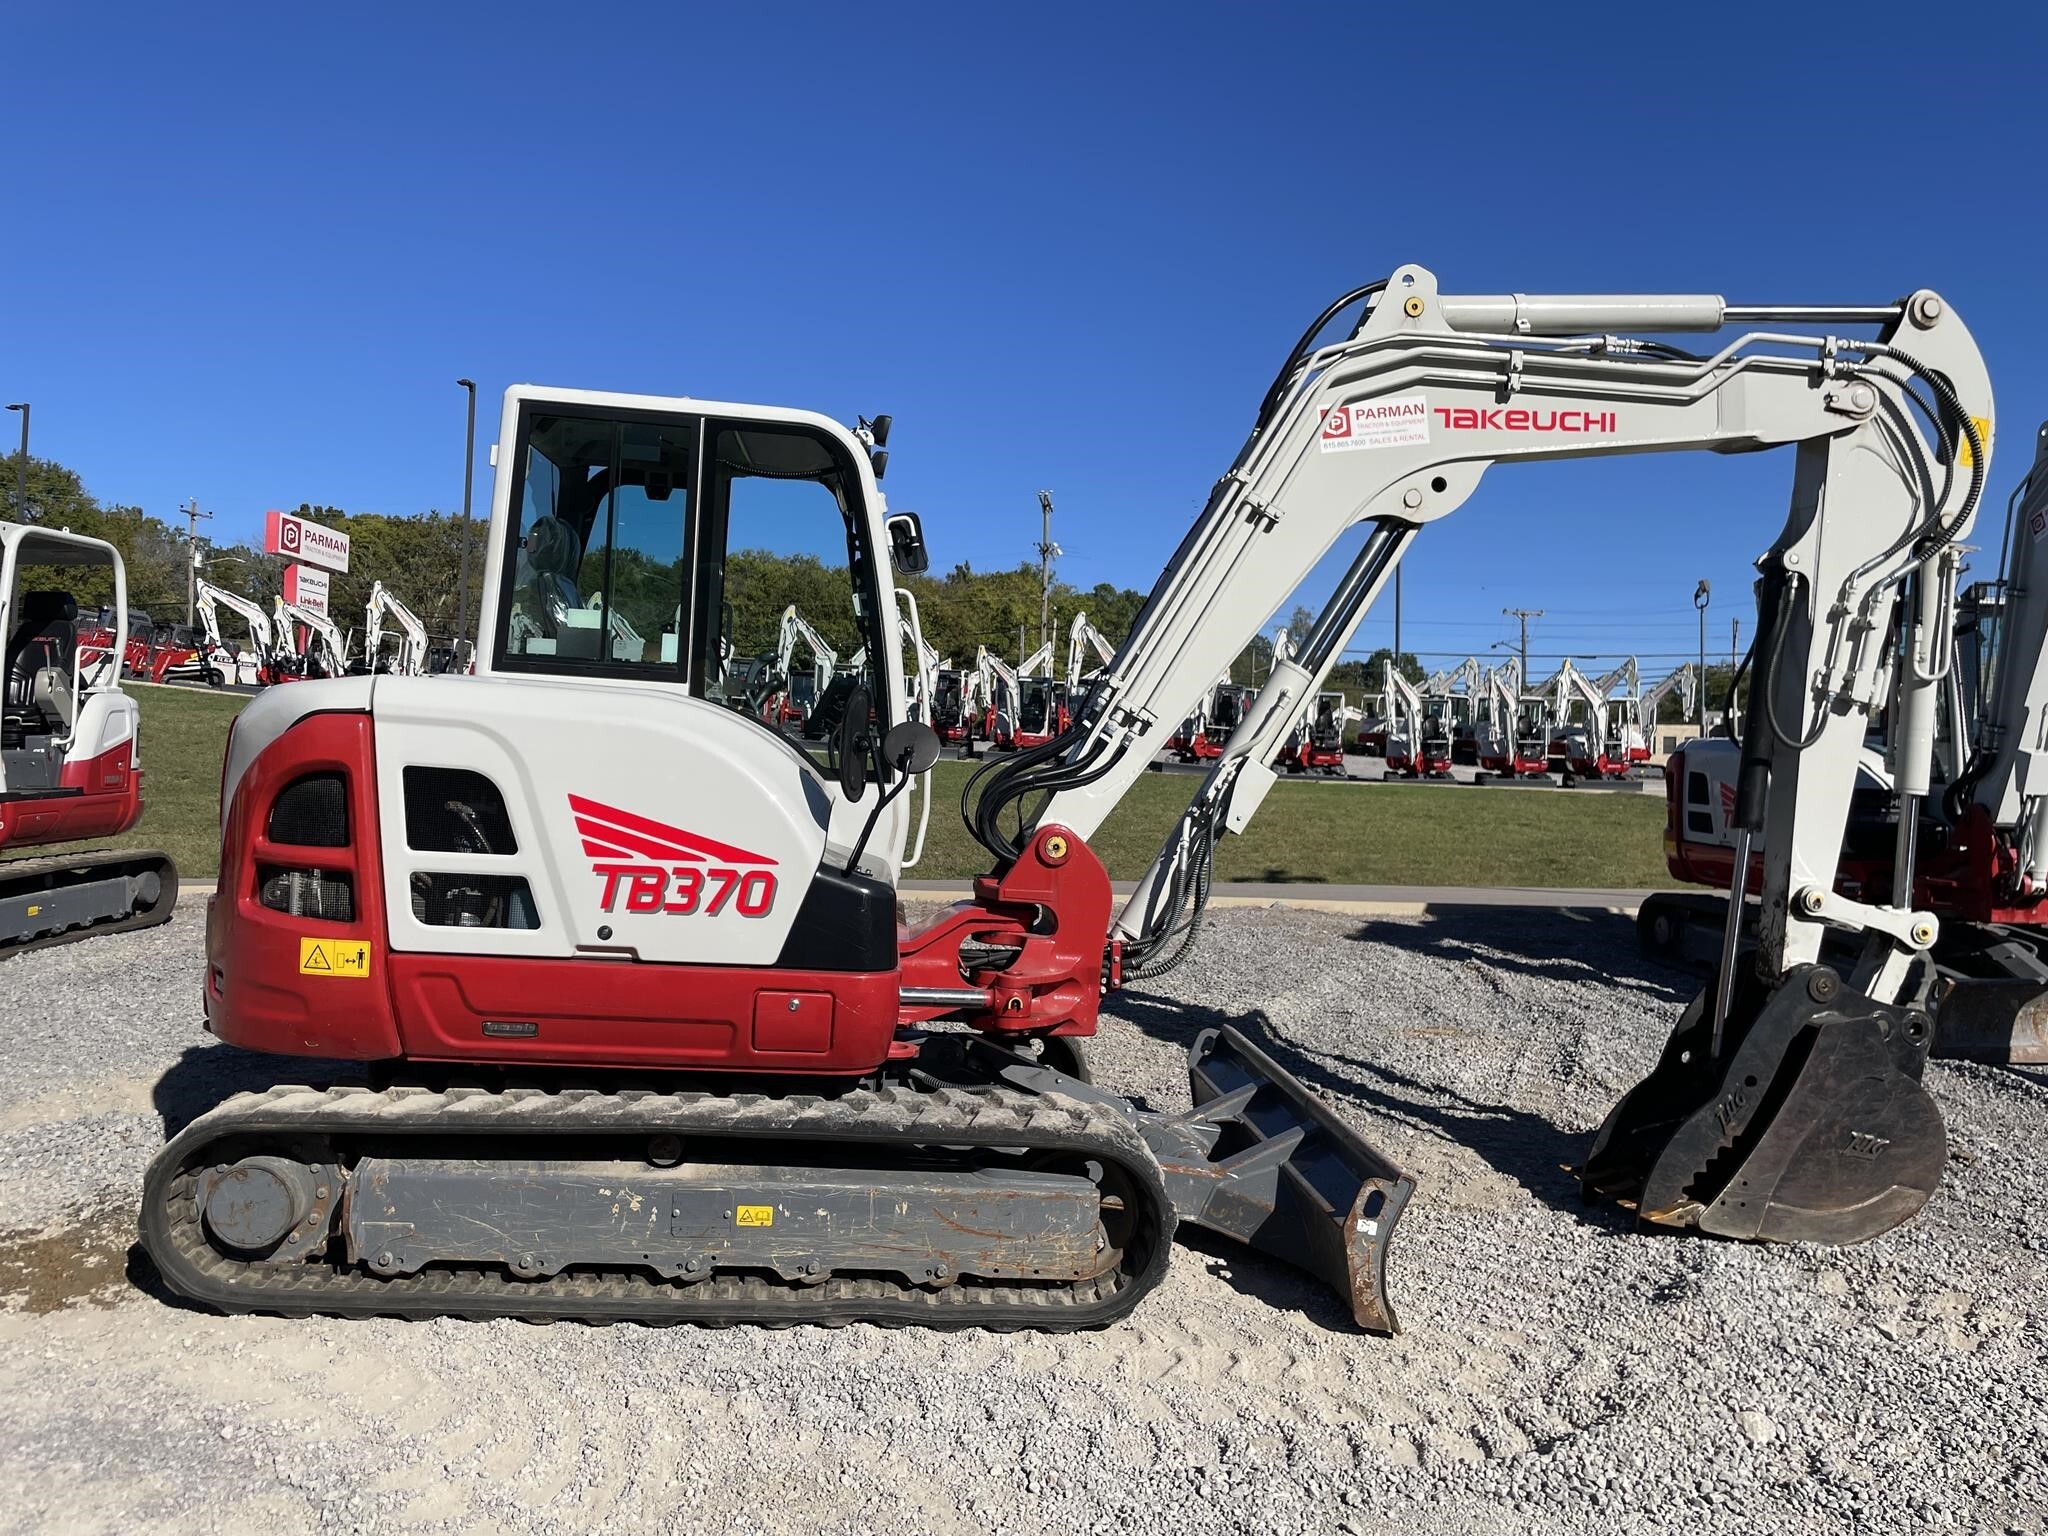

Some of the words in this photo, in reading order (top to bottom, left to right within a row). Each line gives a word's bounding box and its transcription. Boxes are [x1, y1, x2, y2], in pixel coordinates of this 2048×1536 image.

[1355, 403, 1425, 421] PARMAN
[1391, 418, 1425, 428] EQUIPMENT
[1369, 437, 1392, 446] SALES
[1399, 433, 1425, 442] RENTAL
[304, 529, 347, 554] PARMAN
[592, 863, 779, 919] TB370
